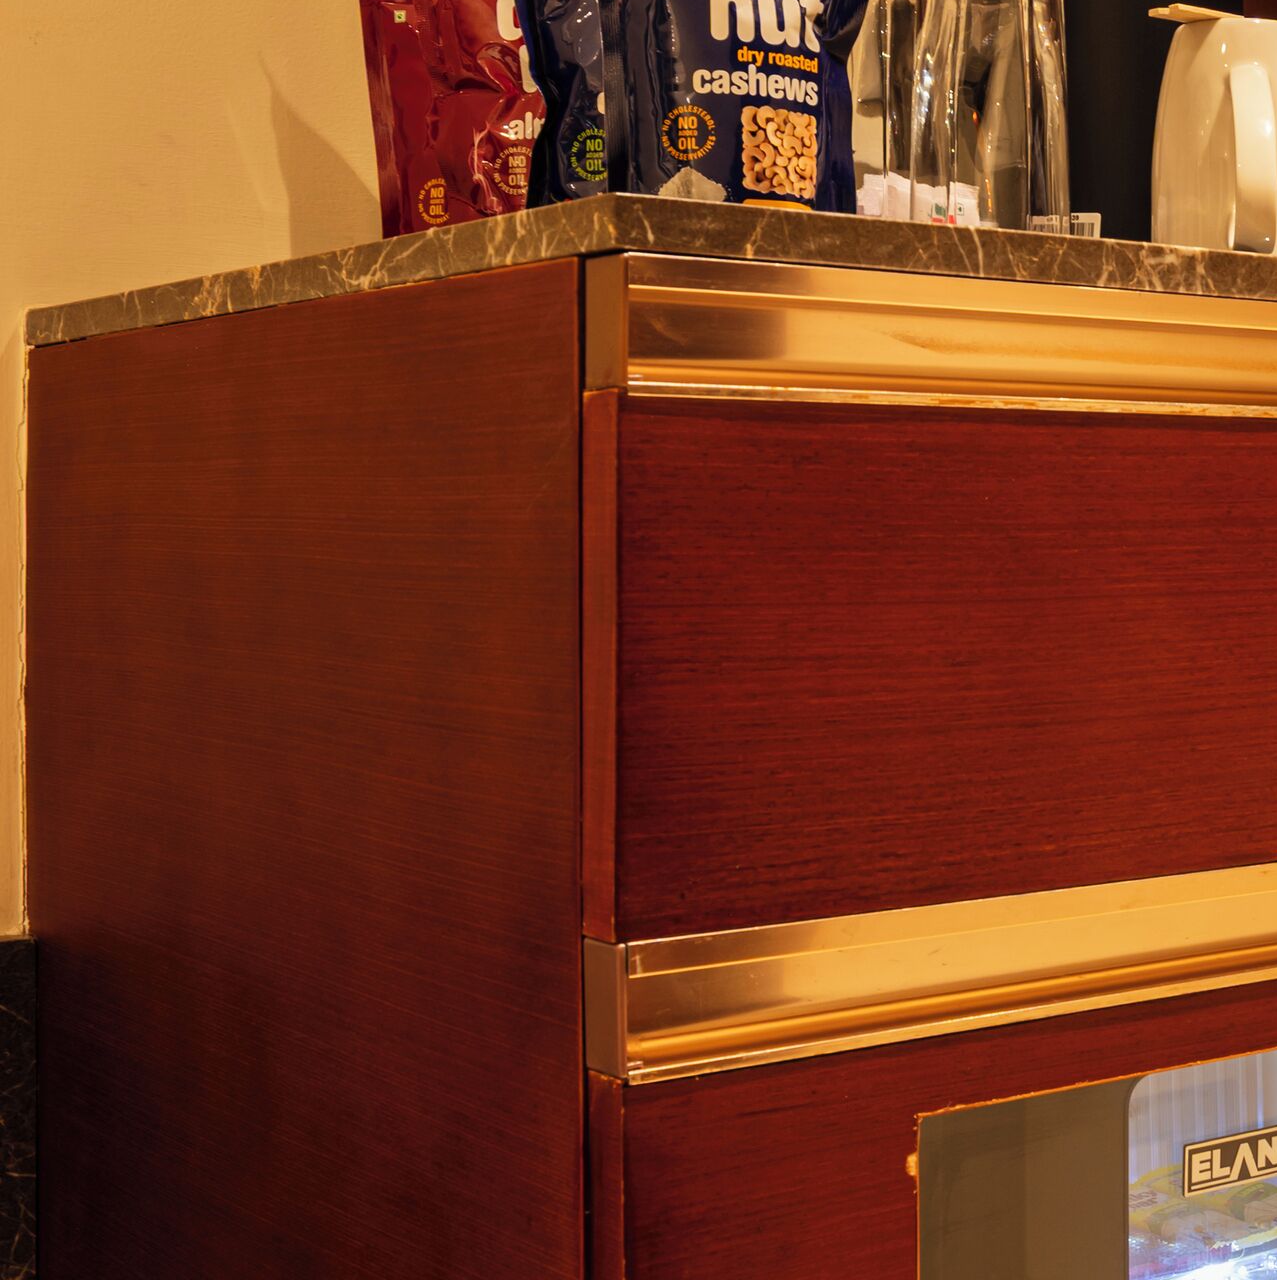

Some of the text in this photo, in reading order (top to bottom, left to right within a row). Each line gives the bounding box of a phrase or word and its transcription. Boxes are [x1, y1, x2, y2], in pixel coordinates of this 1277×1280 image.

[737, 46, 818, 73] dry roasted
[692, 64, 819, 106] cashews
[678, 116, 698, 129] NO
[586, 138, 603, 152] NO
[678, 137, 699, 151] OIL
[586, 160, 606, 171] OIL
[430, 187, 445, 198] NO
[429, 205, 445, 215] OIL
